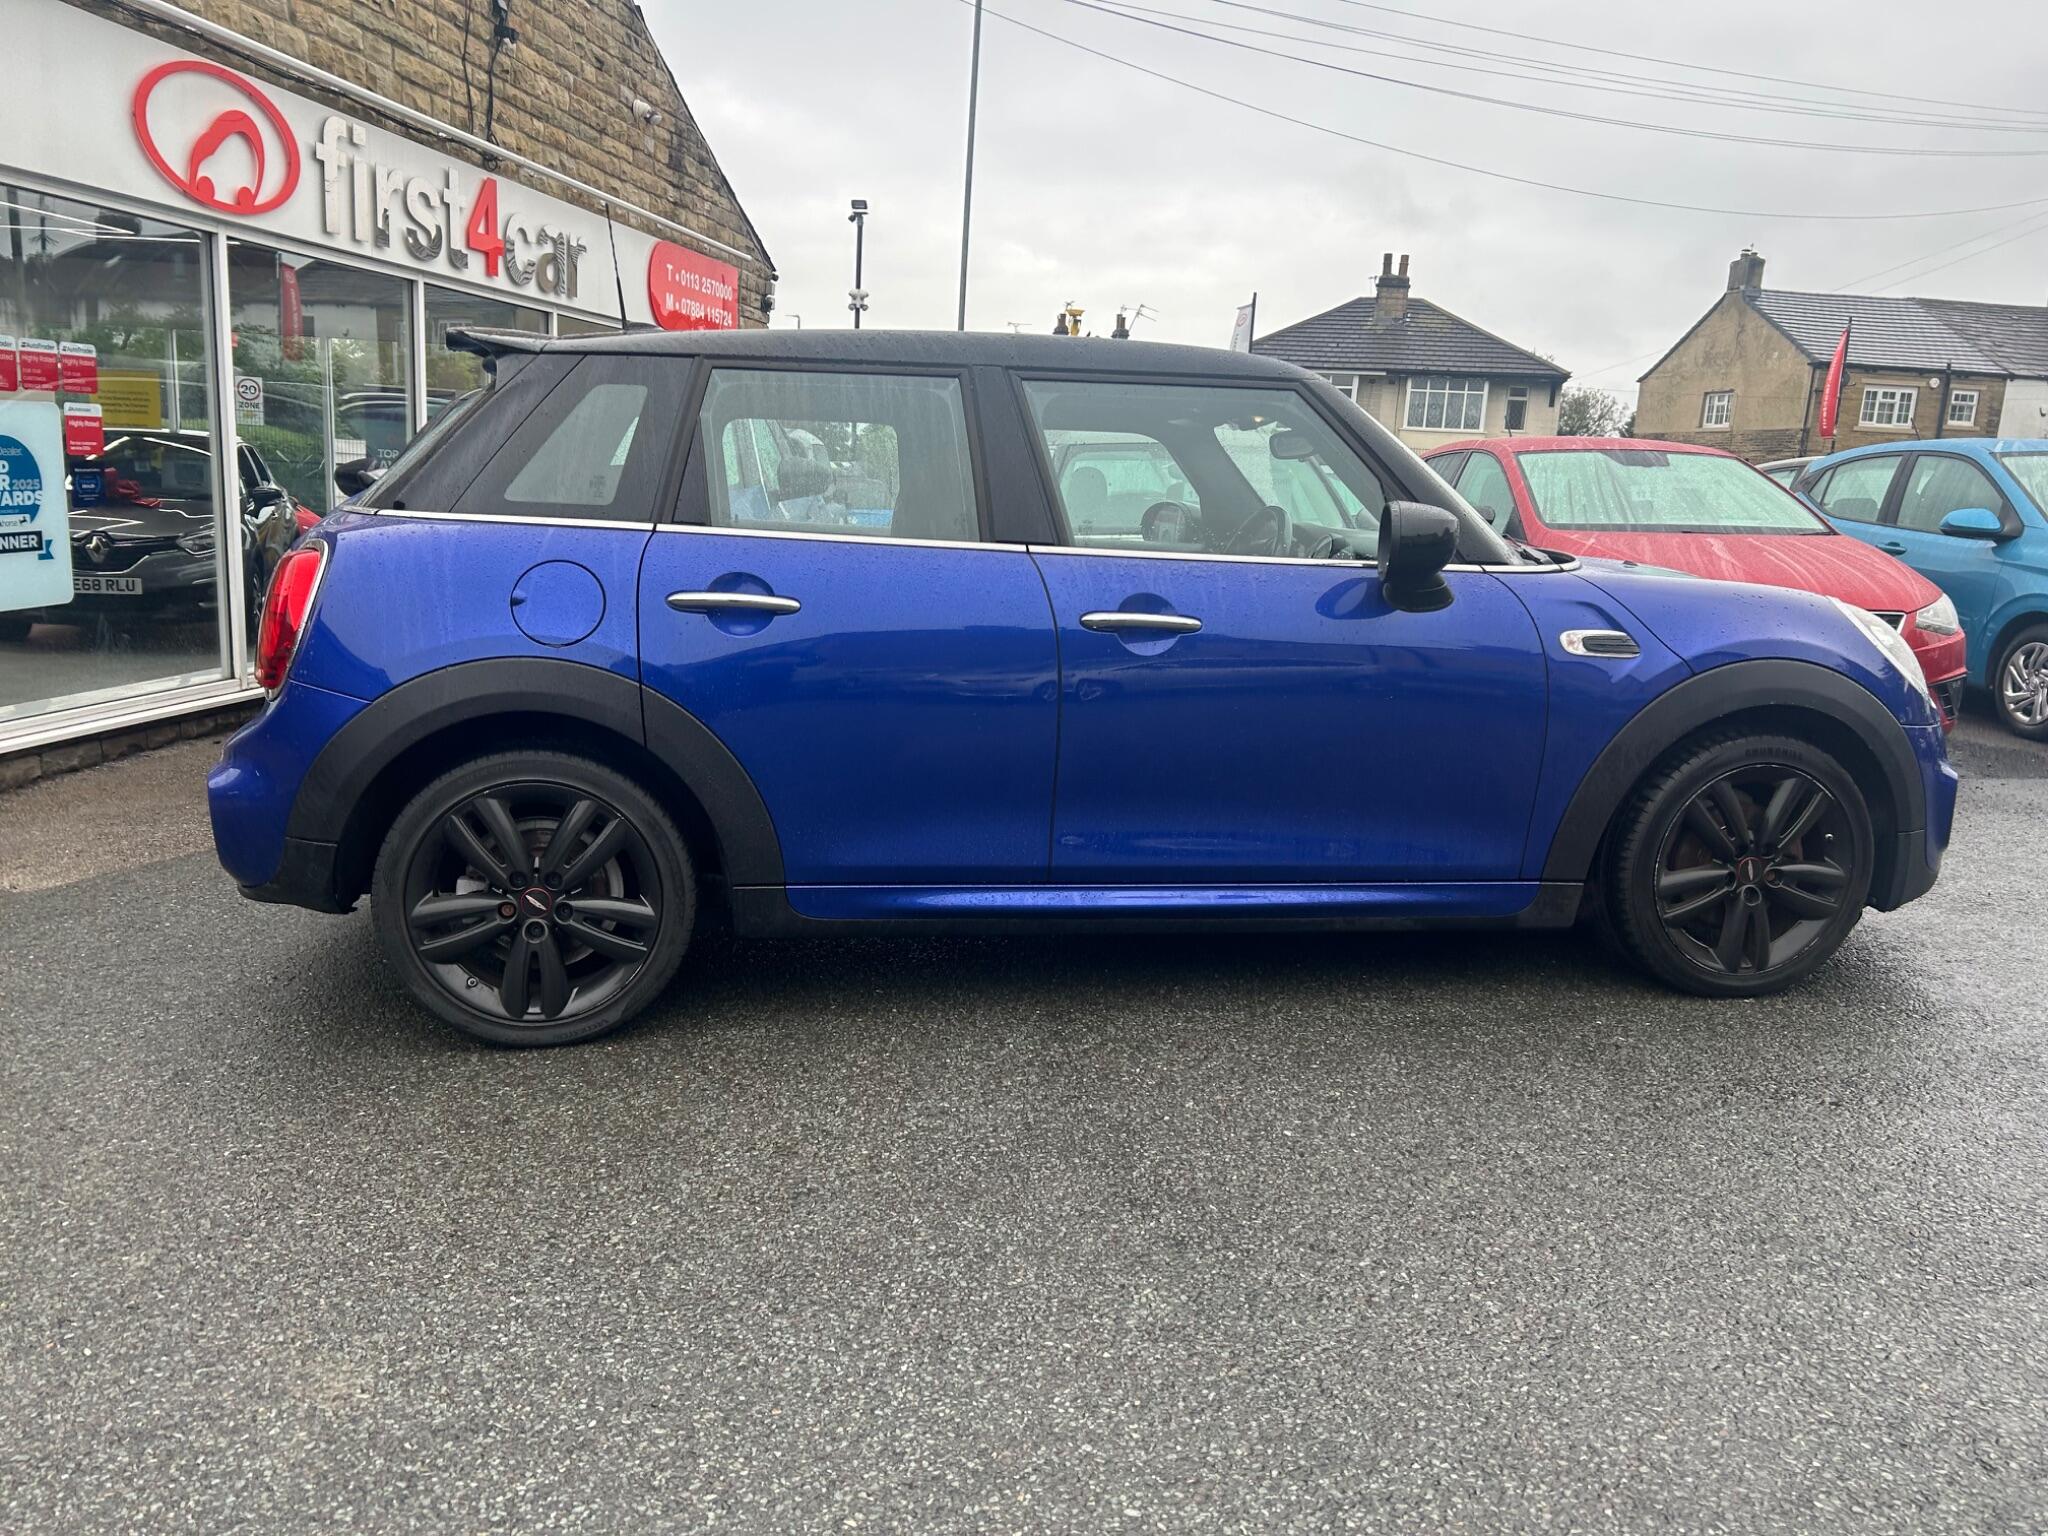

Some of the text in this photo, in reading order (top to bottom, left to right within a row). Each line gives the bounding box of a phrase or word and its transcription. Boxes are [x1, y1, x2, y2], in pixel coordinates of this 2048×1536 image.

[315, 115, 587, 299] first4car
[666, 263, 733, 302] T 0113 2570000
[666, 292, 732, 327] M 07884 115724
[240, 384, 257, 395] 20
[238, 401, 260, 409] ZONE
[377, 448, 399, 459] TOP
[12, 479, 40, 490] 2025
[105, 580, 135, 592] RLU
